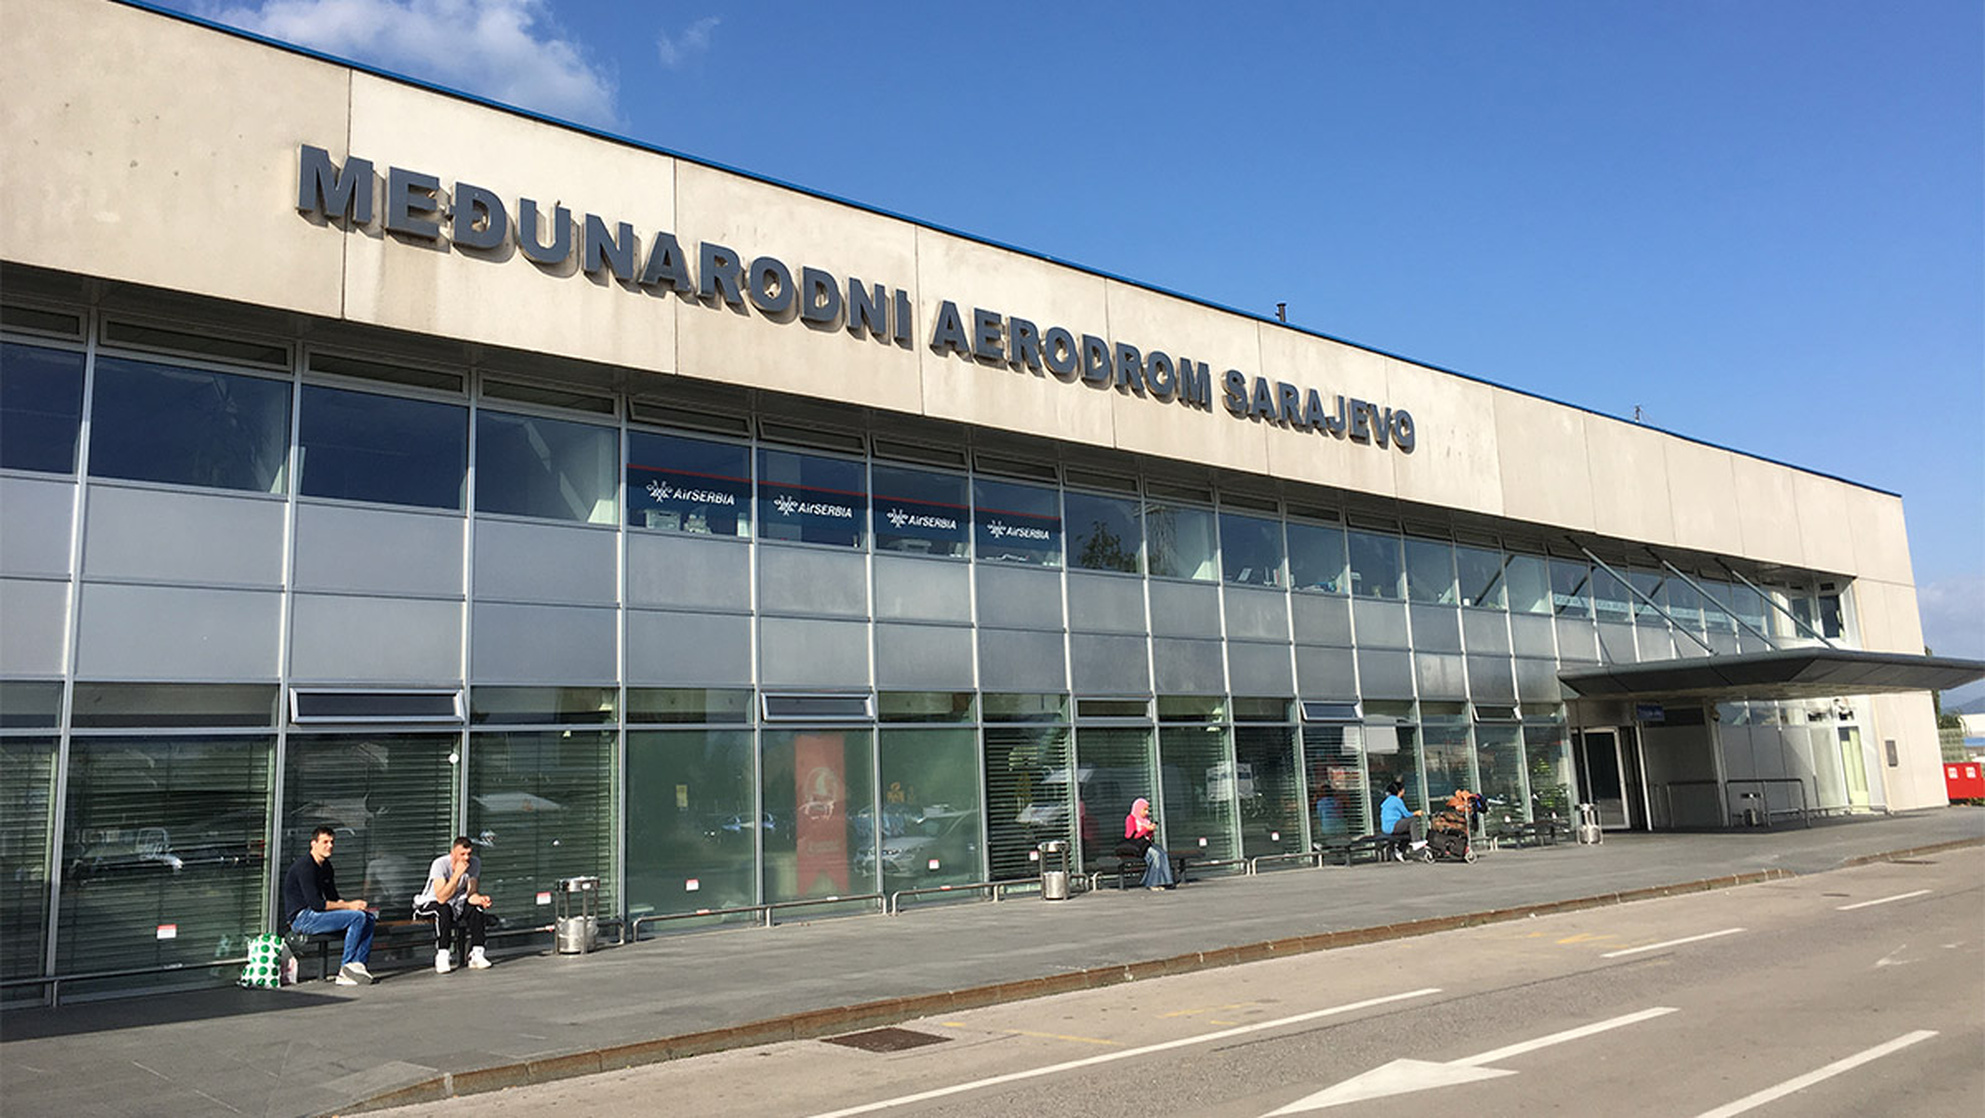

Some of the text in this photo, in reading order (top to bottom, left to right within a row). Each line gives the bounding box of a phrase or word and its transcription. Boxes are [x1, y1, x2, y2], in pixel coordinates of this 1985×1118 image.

[297, 144, 1415, 452] MEĐUNARODNI AERODROM SARAJEVO
